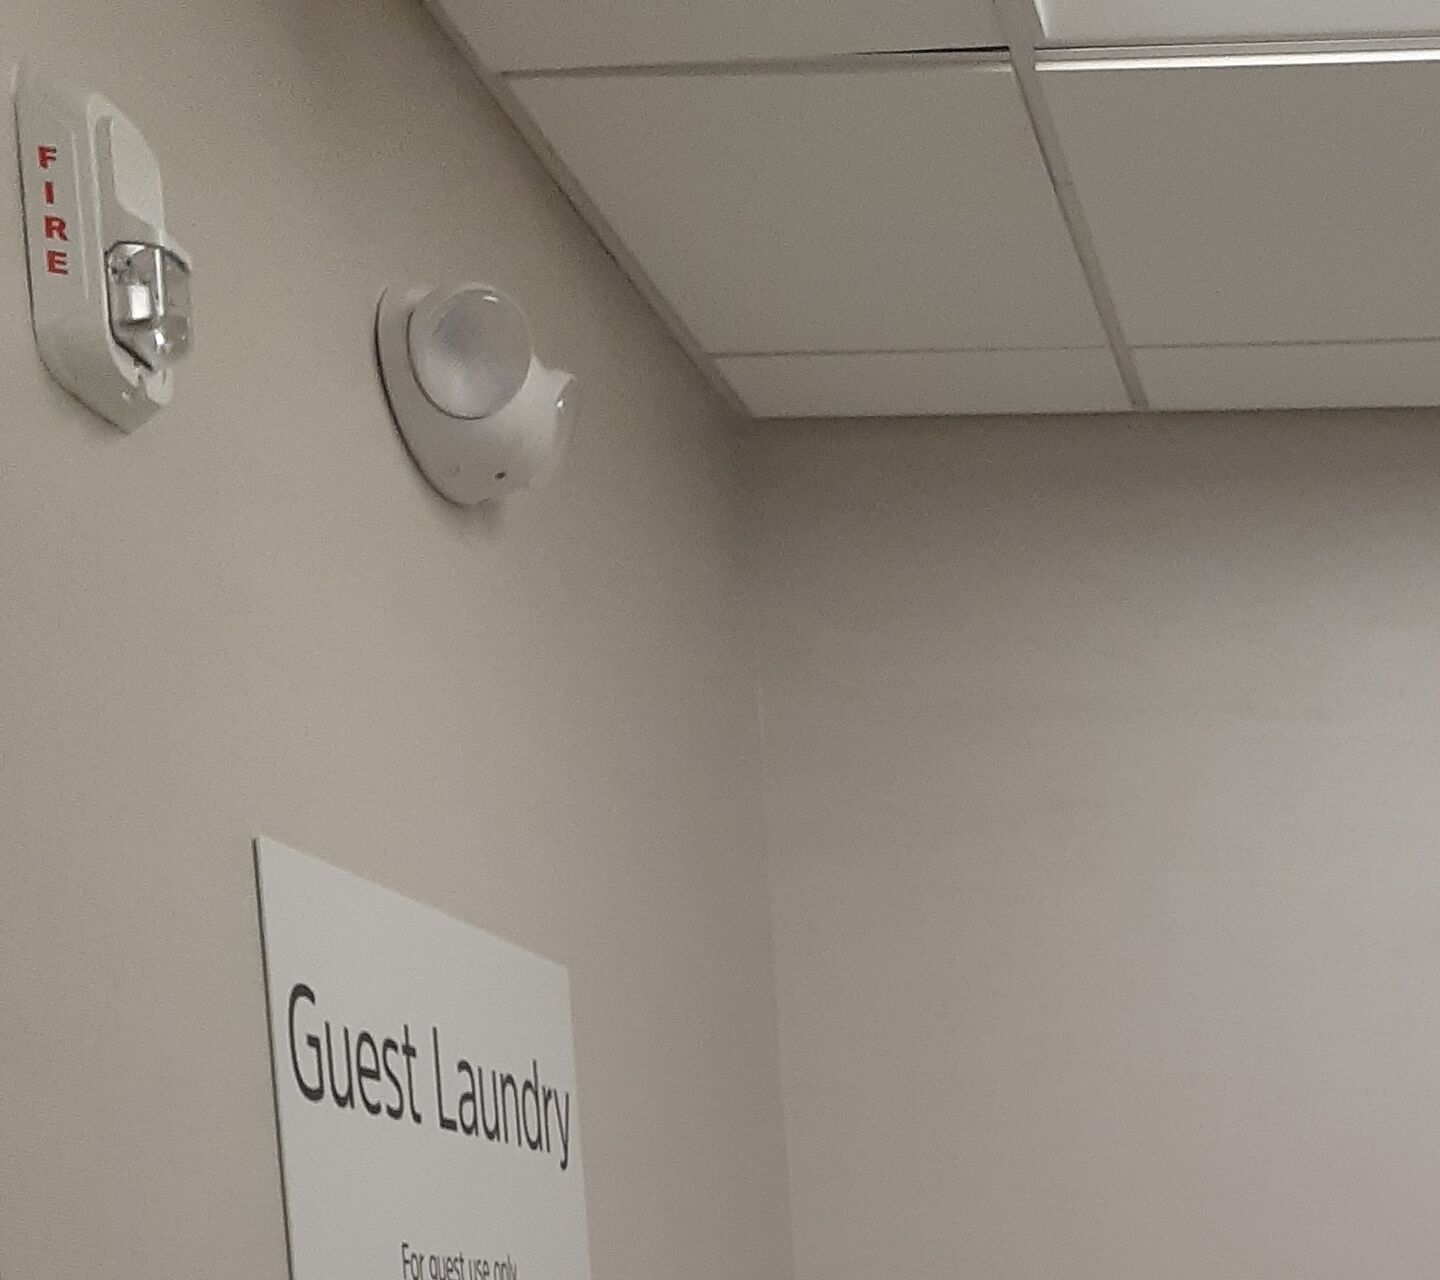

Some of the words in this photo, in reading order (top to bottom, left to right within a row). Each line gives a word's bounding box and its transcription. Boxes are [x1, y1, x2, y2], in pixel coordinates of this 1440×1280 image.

[38, 145, 69, 275] FIRE
[288, 983, 422, 1124] Guest
[432, 1026, 570, 1171] Laundry
